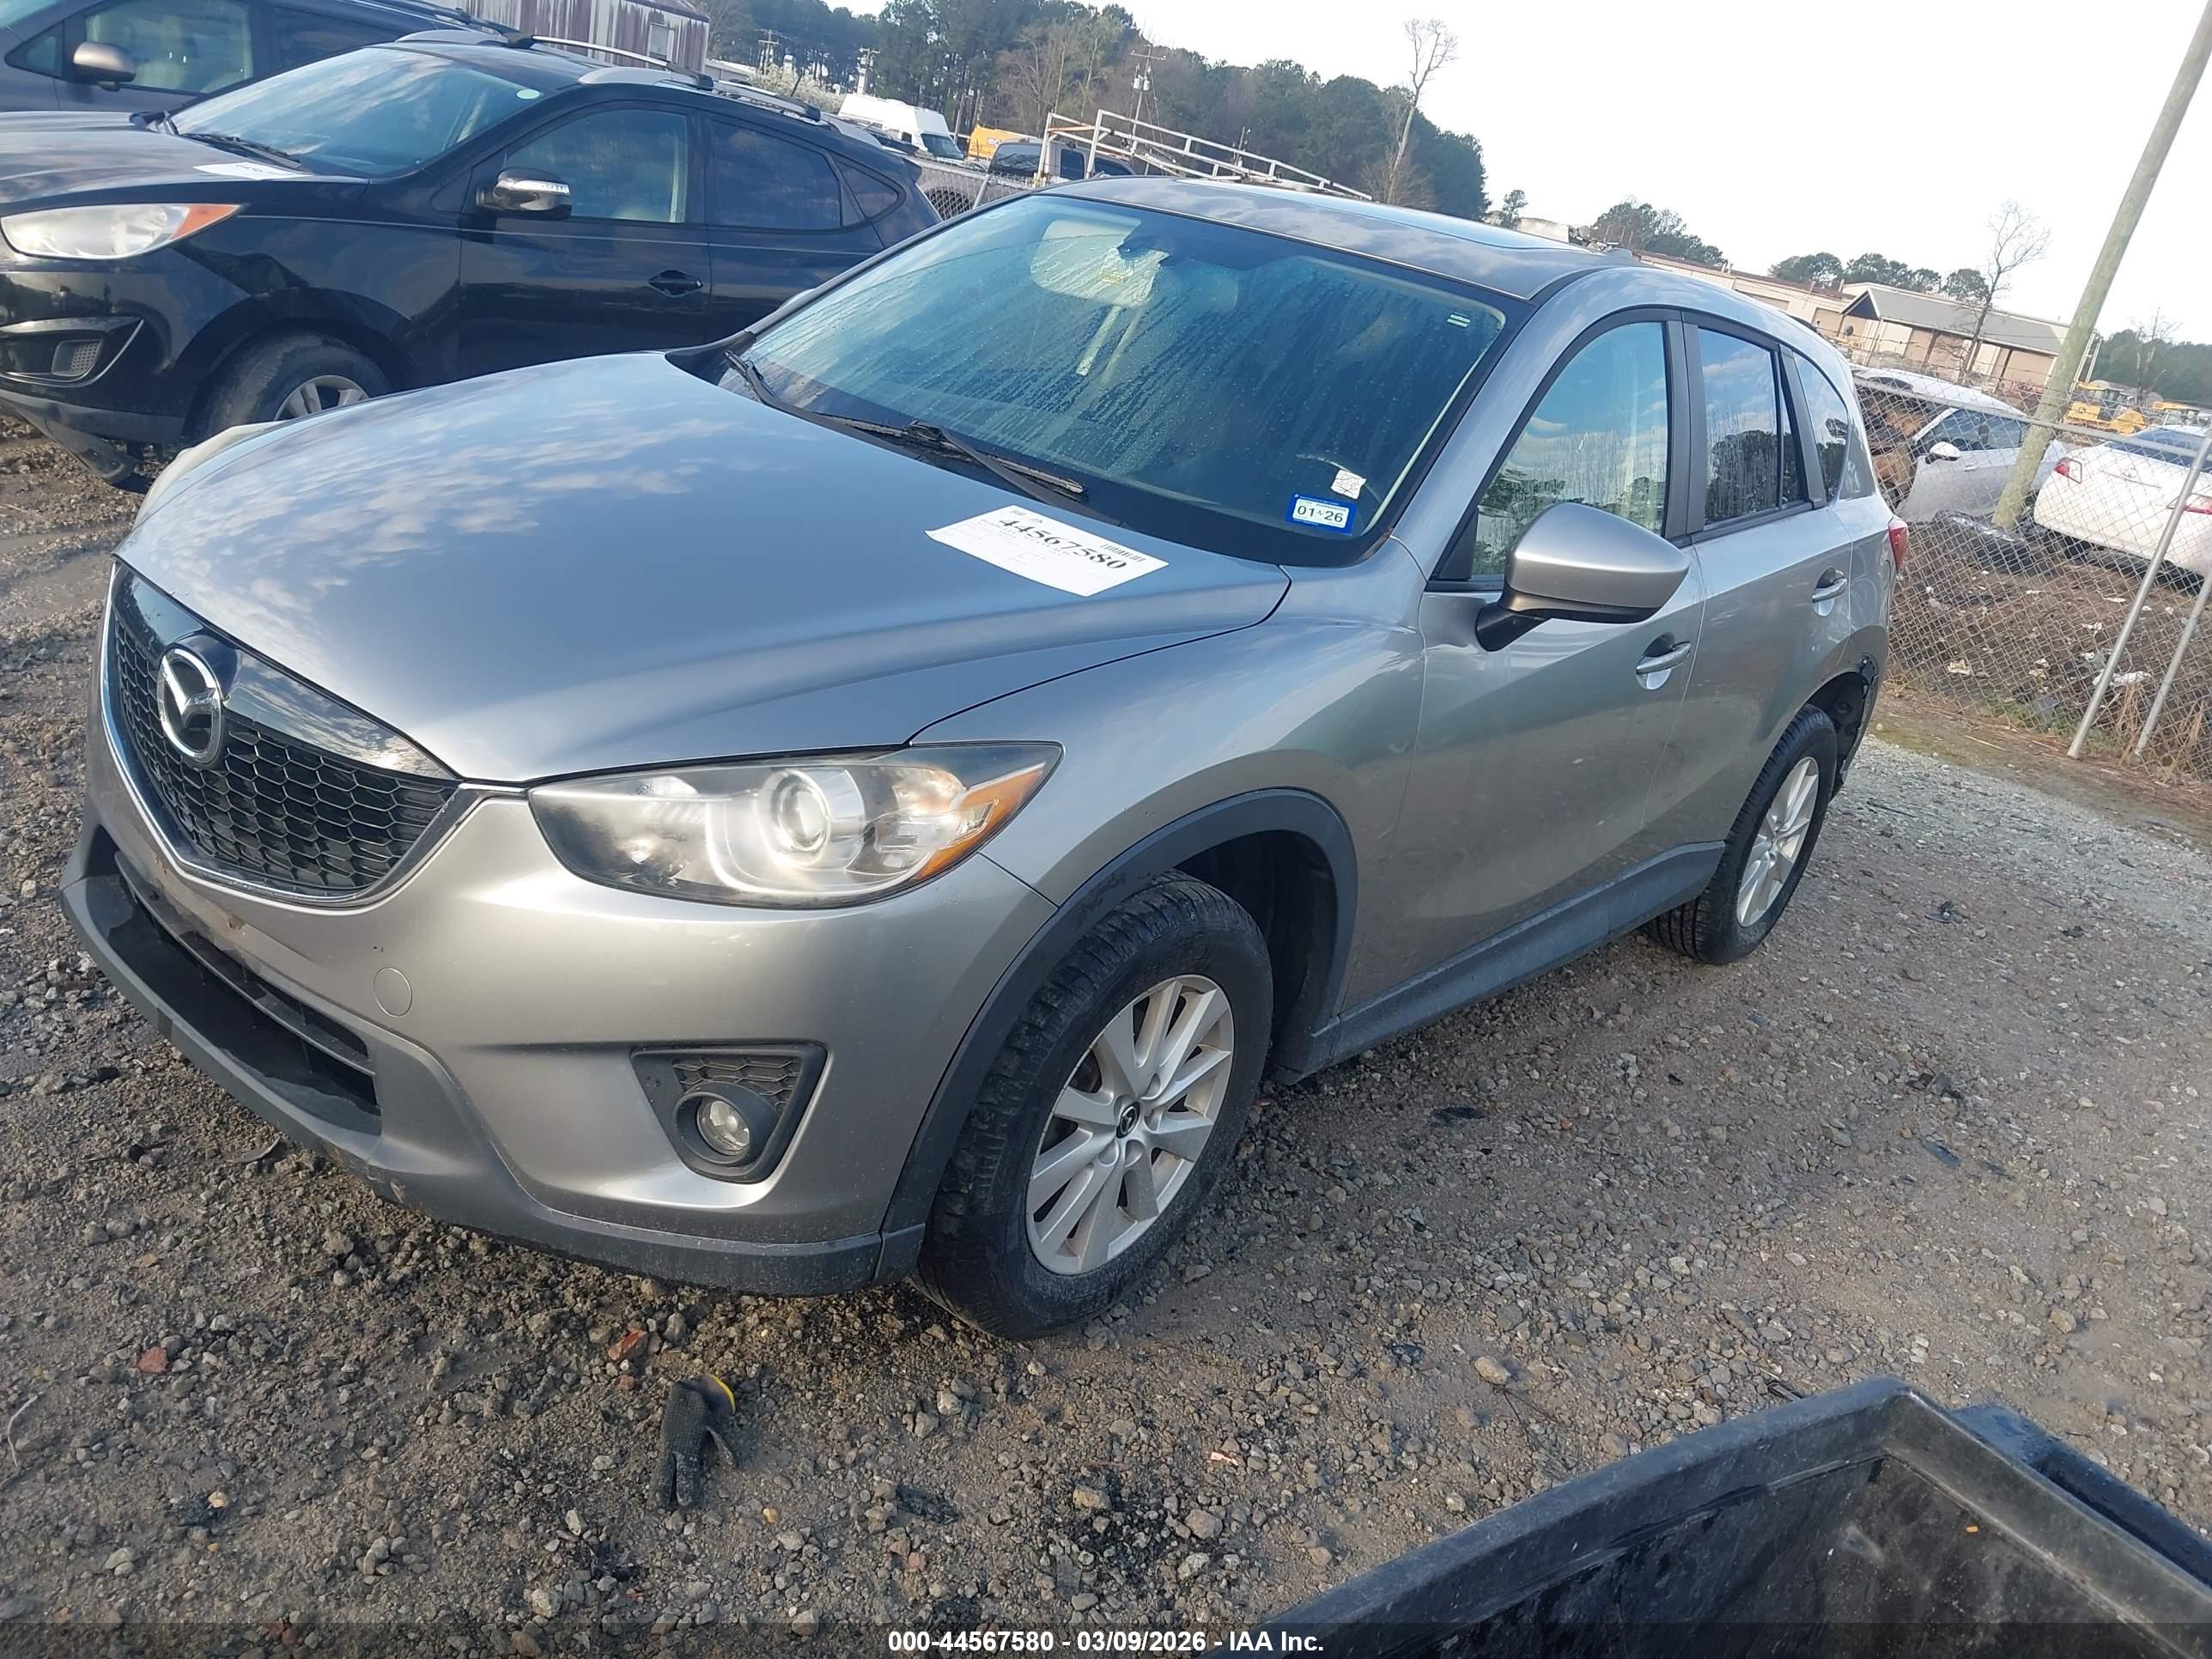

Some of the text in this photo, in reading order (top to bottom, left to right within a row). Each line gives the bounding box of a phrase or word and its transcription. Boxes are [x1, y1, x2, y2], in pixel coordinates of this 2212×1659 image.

[1297, 505, 1315, 517] 01
[1325, 511, 1344, 523] 26
[1000, 519, 1127, 569] 44567580
